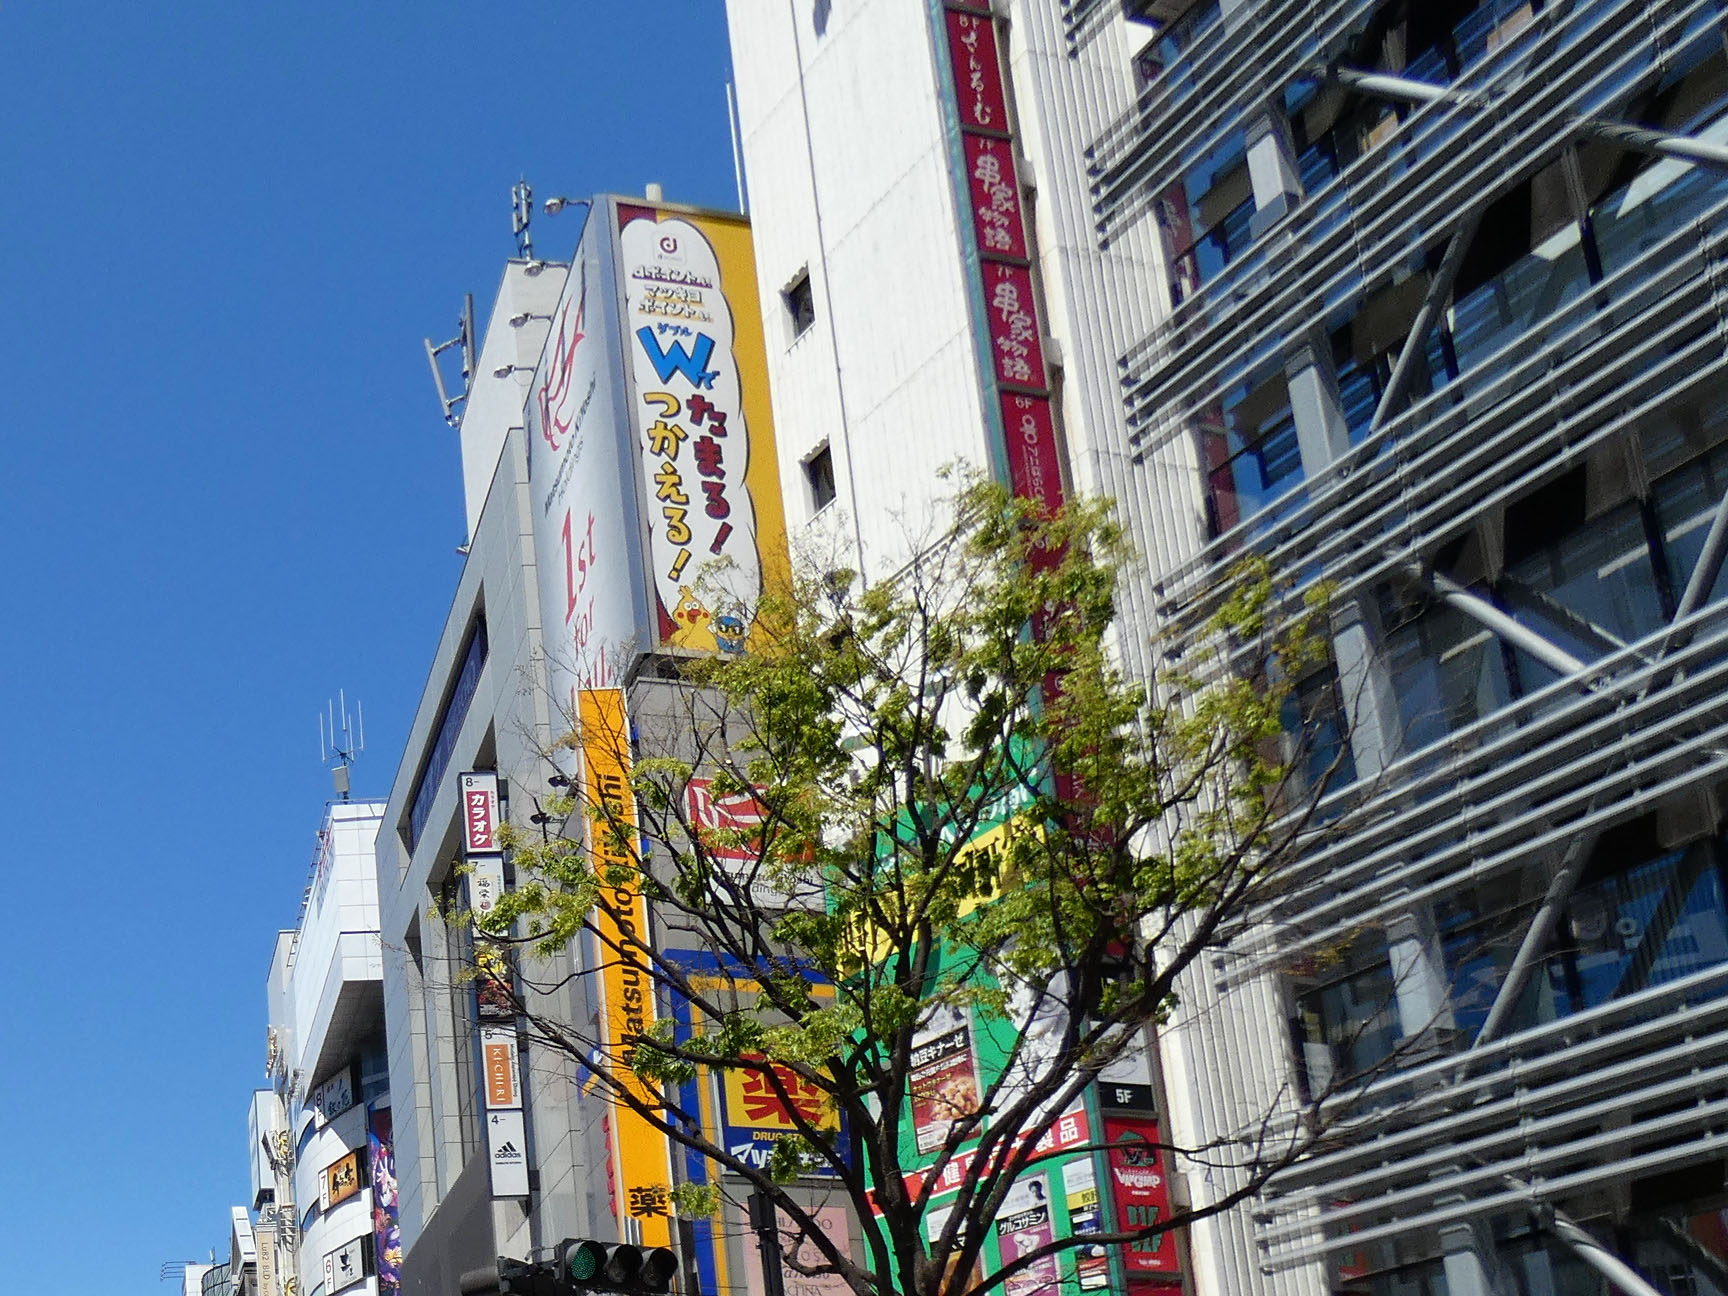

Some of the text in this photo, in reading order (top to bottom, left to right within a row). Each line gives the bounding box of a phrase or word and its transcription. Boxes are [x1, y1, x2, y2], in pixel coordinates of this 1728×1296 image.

[643, 392, 693, 583] つかえる!
[470, 793, 490, 847] カラオケ
[1115, 1088, 1133, 1104] 5F
[494, 1151, 522, 1159] adidas
[630, 1185, 670, 1218] 薬
[999, 1212, 1047, 1234] グルコサミン
[1127, 1204, 1160, 1227] B1F
